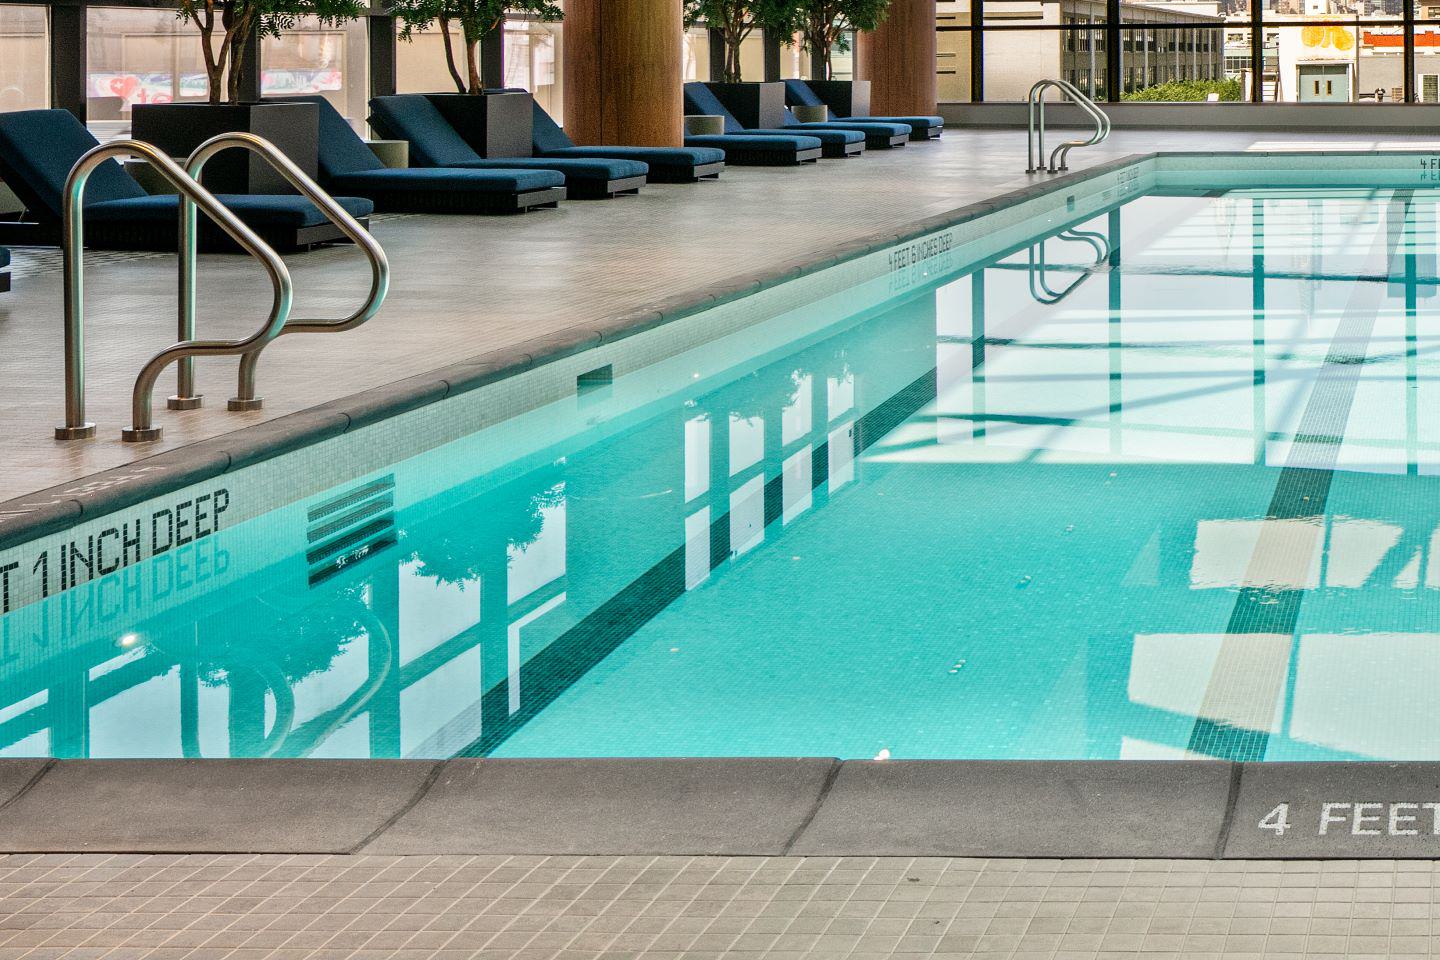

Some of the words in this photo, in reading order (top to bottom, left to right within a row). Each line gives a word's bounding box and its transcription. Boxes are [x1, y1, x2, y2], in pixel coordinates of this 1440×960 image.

[1421, 158, 1427, 169] 4
[894, 247, 910, 271] FEET
[938, 232, 952, 253] DEEP
[33, 551, 48, 598] 1
[61, 518, 141, 591] INCH
[152, 488, 230, 556] DEEP
[1257, 802, 1291, 836] 4
